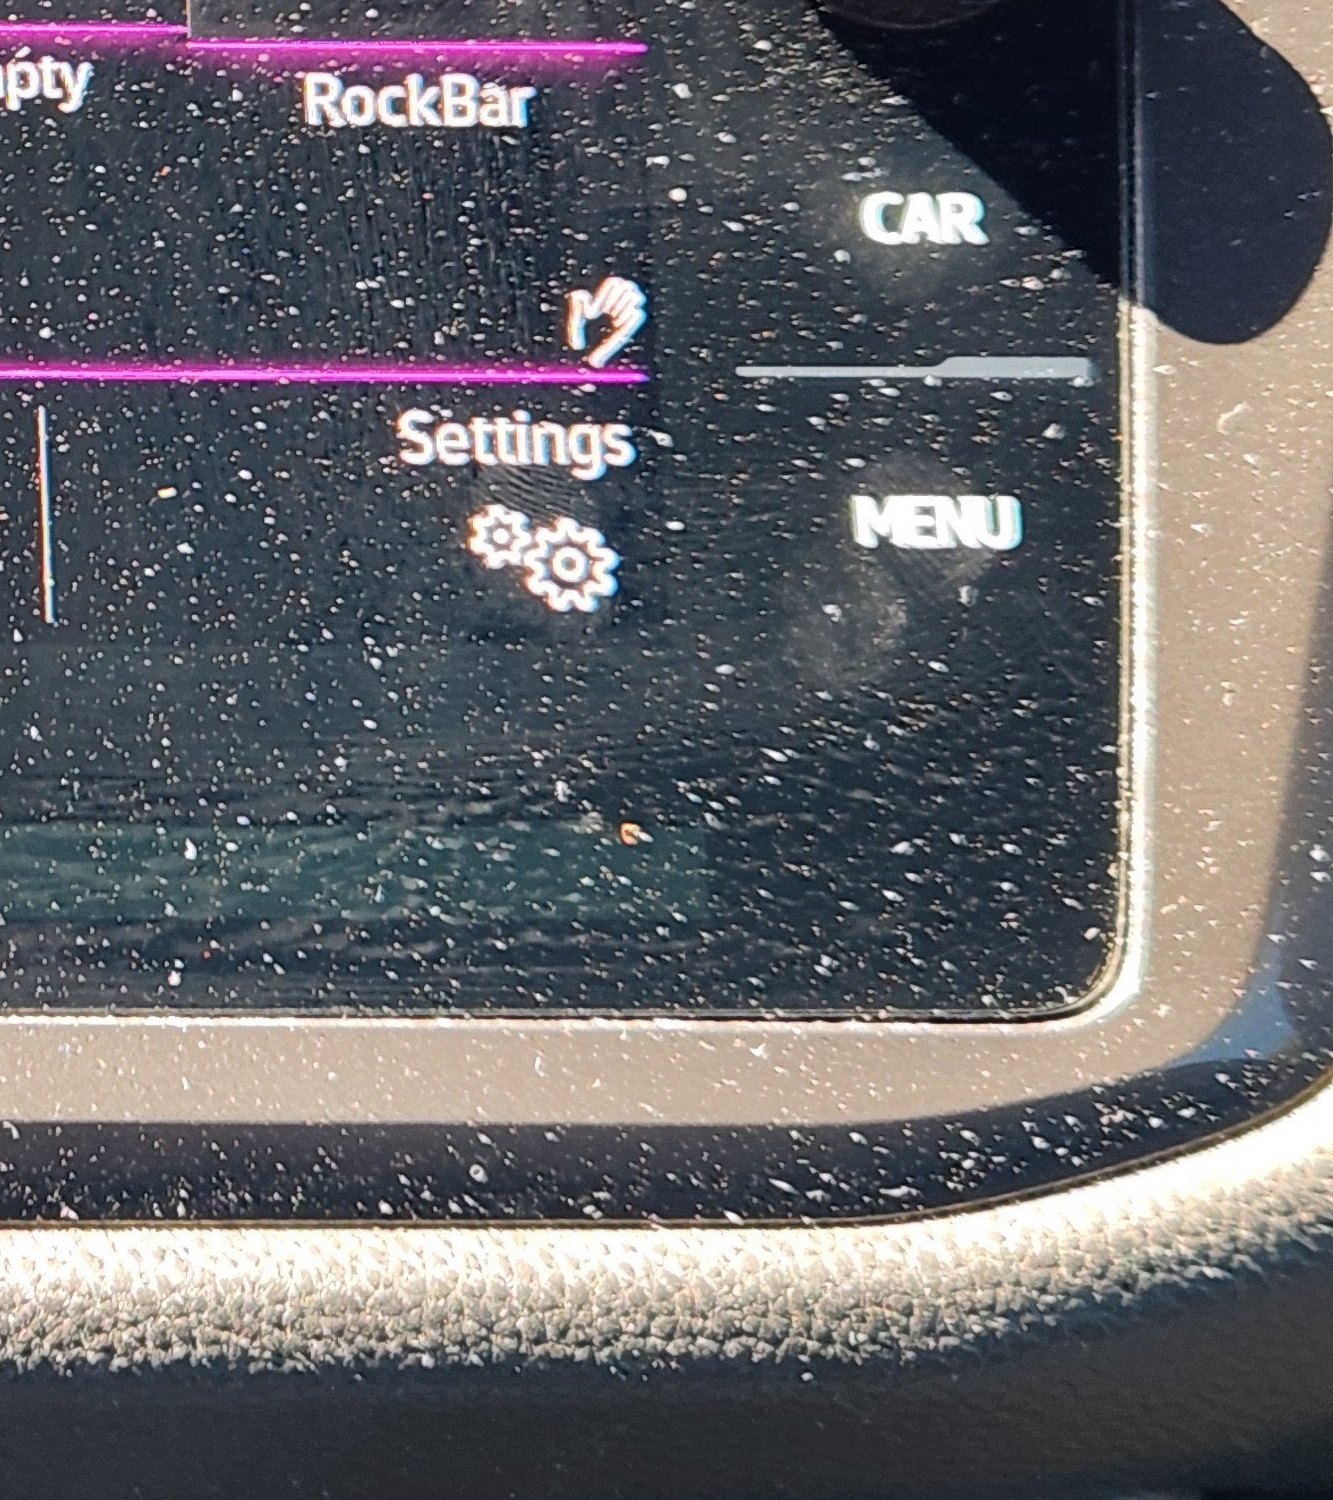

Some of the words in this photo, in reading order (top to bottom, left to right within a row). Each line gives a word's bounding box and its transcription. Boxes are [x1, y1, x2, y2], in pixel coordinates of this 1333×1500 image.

[301, 72, 537, 134] RockBar
[858, 190, 990, 245] CAR
[395, 409, 638, 481] Settings
[850, 494, 1023, 550] MENU
